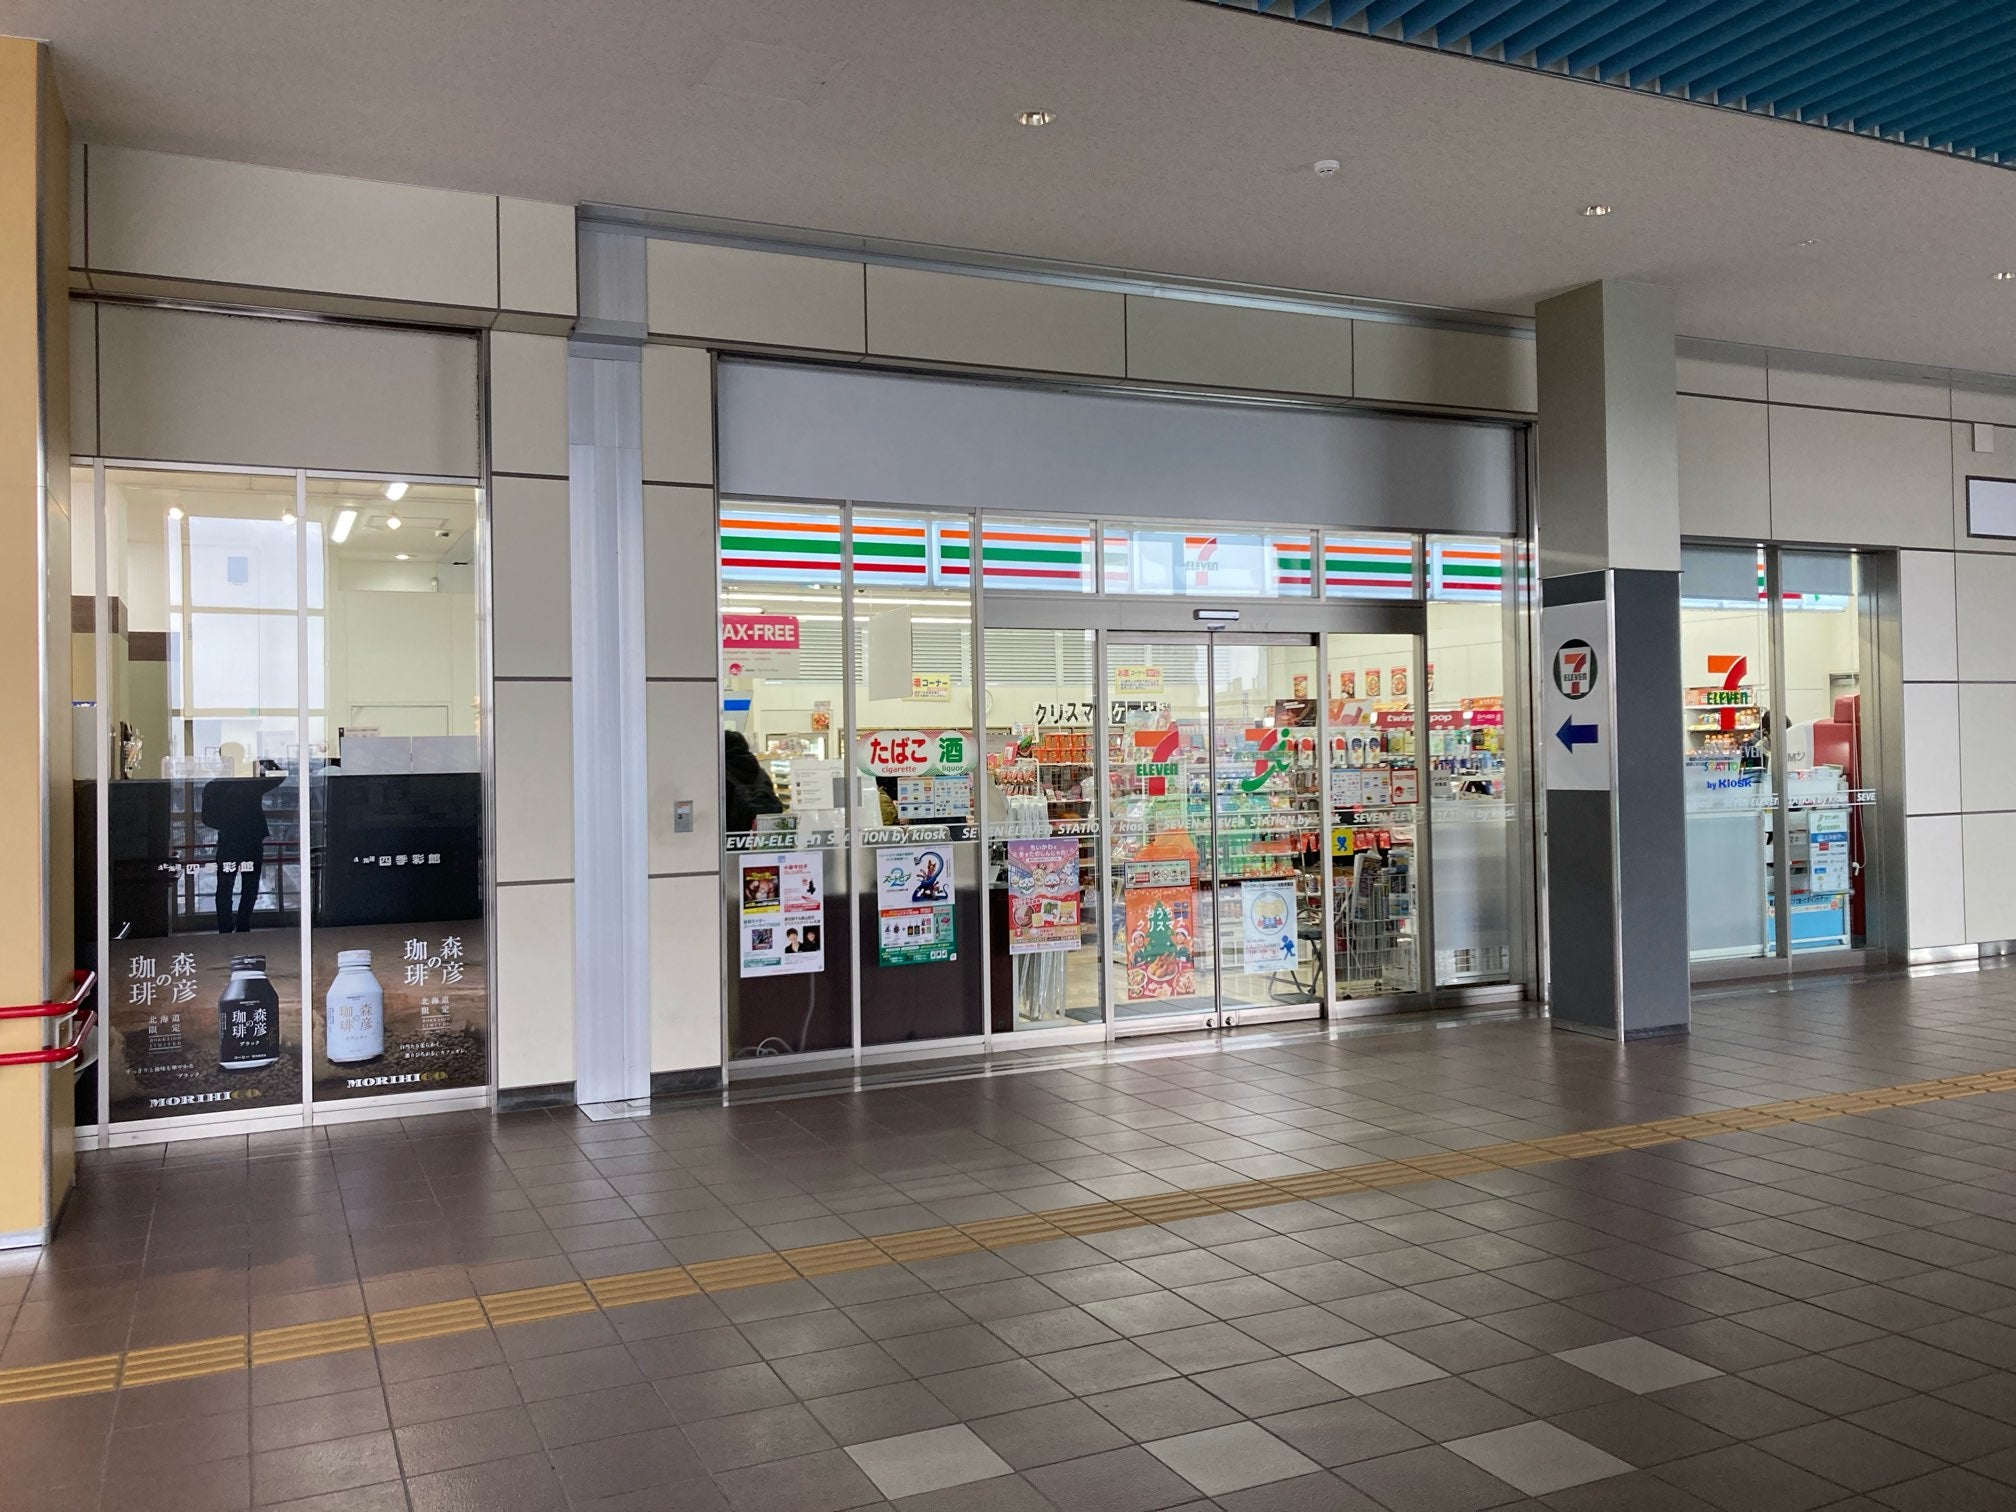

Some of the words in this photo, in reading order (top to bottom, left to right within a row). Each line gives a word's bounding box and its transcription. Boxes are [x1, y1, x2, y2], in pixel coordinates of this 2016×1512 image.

[723, 623, 795, 641] AX-FREE
[870, 737, 928, 764] たばこ
[939, 738, 963, 763] 酒
[881, 766, 917, 774] cigarette
[941, 765, 964, 773] liquor
[892, 831, 907, 843] by
[912, 828, 947, 841] kiosk
[1057, 822, 1100, 835] STATIO
[379, 853, 441, 866] 四季彩館
[187, 861, 254, 875] 四季彩館
[1146, 907, 1173, 919] おうち
[1136, 917, 1185, 932] クリスマス
